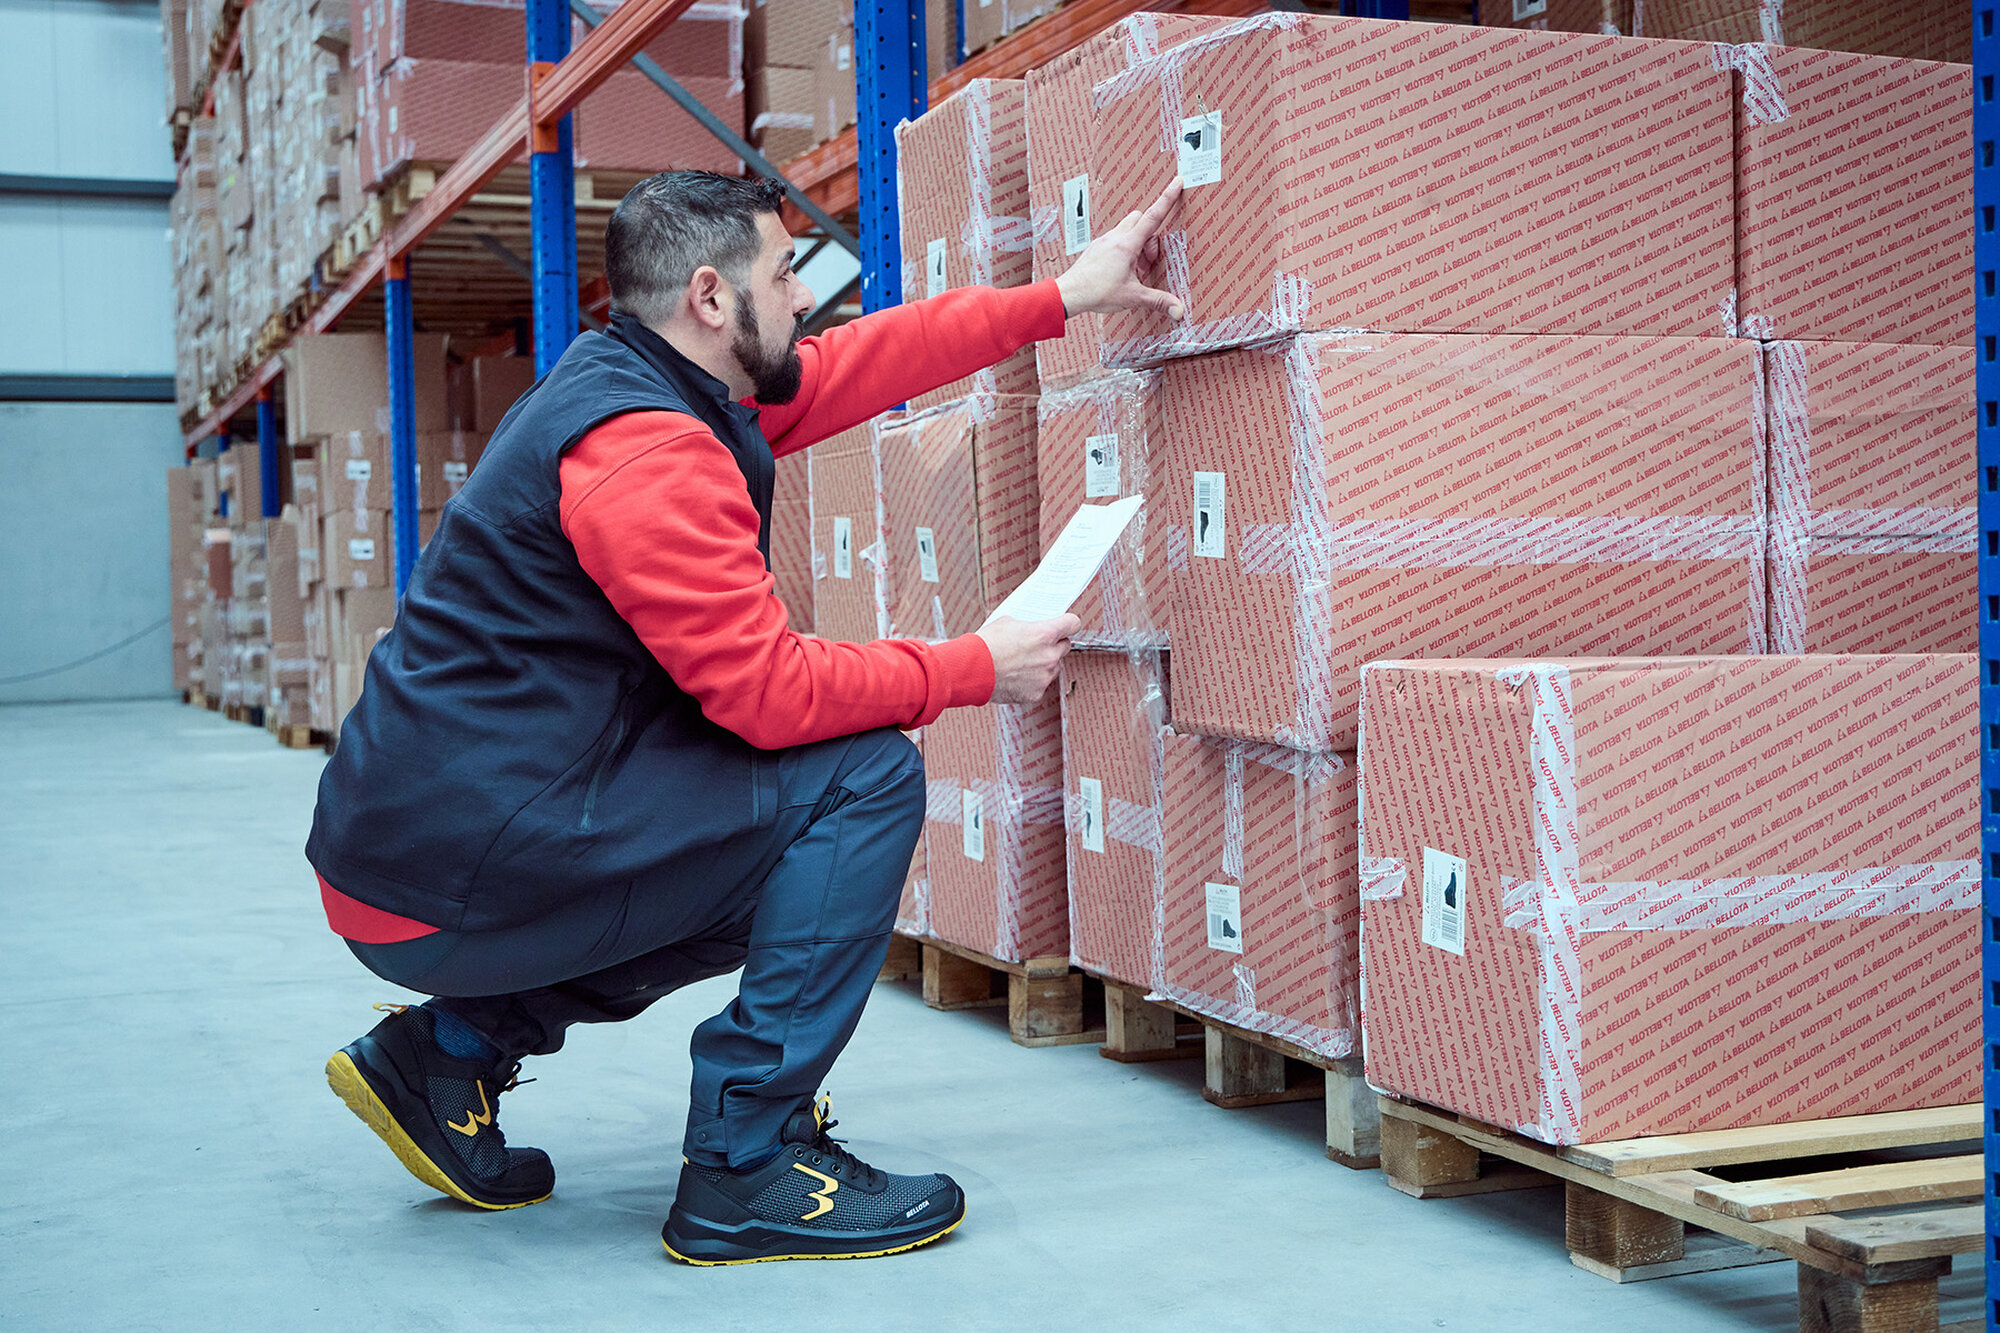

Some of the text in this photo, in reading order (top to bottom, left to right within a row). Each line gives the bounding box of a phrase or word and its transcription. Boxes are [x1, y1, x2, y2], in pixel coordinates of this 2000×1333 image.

[1325, 40, 1356, 58] BELLOTA
[1428, 40, 1458, 59] BELLOTA
[1526, 41, 1555, 59] BELLOTA
[1621, 43, 1648, 60] BELLOTA
[1280, 59, 1312, 78] BELLOTA
[1901, 88, 1926, 106] BELLOTA
[1259, 118, 1280, 146] BELLOTA
[1419, 112, 1448, 130] BELLOTA
[1702, 112, 1729, 129] BELLOTA
[1271, 133, 1301, 152] BELLOTA
[1309, 137, 1340, 156] BELLOTA
[1510, 136, 1539, 153] BELLOTA
[1268, 157, 1296, 177] BELLOTA
[1445, 188, 1474, 206] BELLOTA
[1578, 190, 1606, 209] BELLOTA
[1877, 200, 1904, 217] BELLOTA
[1292, 234, 1324, 254] BELLOTA
[1700, 239, 1726, 256] BELLOTA
[1767, 229, 1795, 246] BELLOTA
[1526, 280, 1554, 298] BELLOTA
[1422, 308, 1452, 326] BELLOTA
[1632, 312, 1660, 331] BELLOTA
[1926, 318, 1950, 334] BELLOTA
[1566, 348, 1593, 367] BELLOTA
[1714, 360, 1741, 378] BELLOTA
[1383, 394, 1413, 414] BELLOTA
[1635, 400, 1662, 418] BELLOTA
[1332, 441, 1364, 462] BELLOTA
[1436, 435, 1466, 454] BELLOTA
[1858, 456, 1884, 474] BELLOTA
[1509, 486, 1538, 506] BELLOTA
[1605, 480, 1632, 499] BELLOTA
[1715, 485, 1742, 504] BELLOTA
[1408, 494, 1438, 513] BELLOTA
[1337, 568, 1370, 588] BELLOTA
[1462, 570, 1492, 591] BELLOTA
[1560, 563, 1590, 582] BELLOTA
[1716, 602, 1742, 620] BELLOTA
[1410, 618, 1440, 638] BELLOTA
[1616, 634, 1645, 654] BELLOTA
[1896, 659, 1926, 682] BELLOTA
[1934, 661, 1965, 684] BELLOTA
[1375, 680, 1387, 716] BELLOTA
[1549, 674, 1570, 714] BELLOTA
[1684, 680, 1715, 704] BELLOTA
[1724, 682, 1756, 706] BELLOTA
[1852, 684, 1883, 707] BELLOTA
[1451, 688, 1464, 726] BELLOTA
[1613, 694, 1648, 717] BELLOTA
[1786, 697, 1818, 720] BELLOTA
[1912, 699, 1942, 722] BELLOTA
[1548, 725, 1570, 764] BELLOTA
[1740, 724, 1772, 747] BELLOTA
[1868, 725, 1898, 748] BELLOTA
[1504, 740, 1518, 780] BELLOTA
[1629, 736, 1662, 760] BELLOTA
[1926, 739, 1956, 762] BELLOTA
[1368, 749, 1380, 784] BELLOTA
[1402, 744, 1415, 782] BELLOTA
[1693, 750, 1726, 774] BELLOTA
[1822, 750, 1854, 774] BELLOTA
[1481, 755, 1494, 795] BELLOTA
[1539, 757, 1561, 797] BELLOTA
[1579, 764, 1614, 789] BELLOTA
[1883, 766, 1912, 788] BELLOTA
[1422, 776, 1436, 814] BELLOTA
[1459, 770, 1472, 810] BELLOTA
[1645, 778, 1678, 802] BELLOTA
[1776, 778, 1809, 802] BELLOTA
[1502, 788, 1517, 830] BELLOTA
[1838, 792, 1869, 816] BELLOTA
[1381, 804, 1394, 841] BELLOTA
[1730, 805, 1762, 829] BELLOTA
[1935, 807, 1966, 830] BELLOTA
[1540, 813, 1562, 853] BELLOTA
[1618, 819, 1652, 843] BELLOTA
[1792, 819, 1824, 842] BELLOTA
[1474, 829, 1488, 868] BELLOTA
[1683, 832, 1716, 857] BELLOTA
[1853, 832, 1884, 856] BELLOTA
[1891, 834, 1922, 859] BELLOTA
[1318, 867, 1350, 888] BELLOTA
[1536, 848, 1554, 887] BELLOTA
[1764, 878, 1796, 898] BELLOTA
[1931, 872, 1960, 894] BELLOTA
[1488, 888, 1502, 928] BELLOTA
[1824, 888, 1855, 911] BELLOTA
[1716, 902, 1748, 925] BELLOTA
[1752, 924, 1785, 946] BELLOTA
[1880, 918, 1911, 942] BELLOTA
[1917, 918, 1949, 943] BELLOTA
[1388, 927, 1400, 966] BELLOTA
[1598, 936, 1633, 962] BELLOTA
[1641, 935, 1675, 962] BELLOTA
[1813, 933, 1845, 958] BELLOTA
[1464, 946, 1478, 989] BELLOTA
[1504, 948, 1517, 990] BELLOTA
[1553, 953, 1573, 992] BELLOTA
[1704, 950, 1737, 975] BELLOTA
[1766, 962, 1798, 987] BELLOTA
[1893, 958, 1923, 982] BELLOTA
[1930, 959, 1962, 982] BELLOTA
[1614, 978, 1648, 1004] BELLOTA
[1656, 978, 1689, 1004] BELLOTA
[1847, 986, 1878, 1010] BELLOTA
[1381, 995, 1394, 1033] BELLOTA
[1436, 984, 1450, 1024] BELLOTA
[1718, 991, 1751, 1016] BELLOTA
[1906, 998, 1936, 1021] BELLOTA
[1480, 1009, 1493, 1048] BELLOTA
[1518, 1010, 1532, 1052] BELLOTA
[1550, 1004, 1570, 1042] BELLOTA
[1628, 1020, 1663, 1046] BELLOTA
[1800, 1014, 1832, 1040] BELLOTA
[1541, 1029, 1558, 1070] BELLOTA
[1692, 1032, 1725, 1056] BELLOTA
[1753, 1043, 1786, 1068] BELLOTA
[1394, 1051, 1407, 1090] BELLOTA
[1450, 1043, 1463, 1084] BELLOTA
[1644, 1061, 1677, 1087] BELLOTA
[1853, 1054, 1884, 1079] BELLOTA
[1912, 1065, 1943, 1090] BELLOTA
[1494, 1070, 1507, 1112] BELLOTA
[1540, 1078, 1554, 1120] BELLOTA
[1767, 1083, 1800, 1108] BELLOTA
[1807, 1083, 1840, 1108] BELLOTA
[1560, 1088, 1578, 1128] BELLOTA
[1594, 1091, 1628, 1118] BELLOTA
[1657, 1102, 1691, 1131] BELLOTA
[1698, 1102, 1731, 1127] BELLOTA
[906, 1201, 930, 1218] BELLOTA
